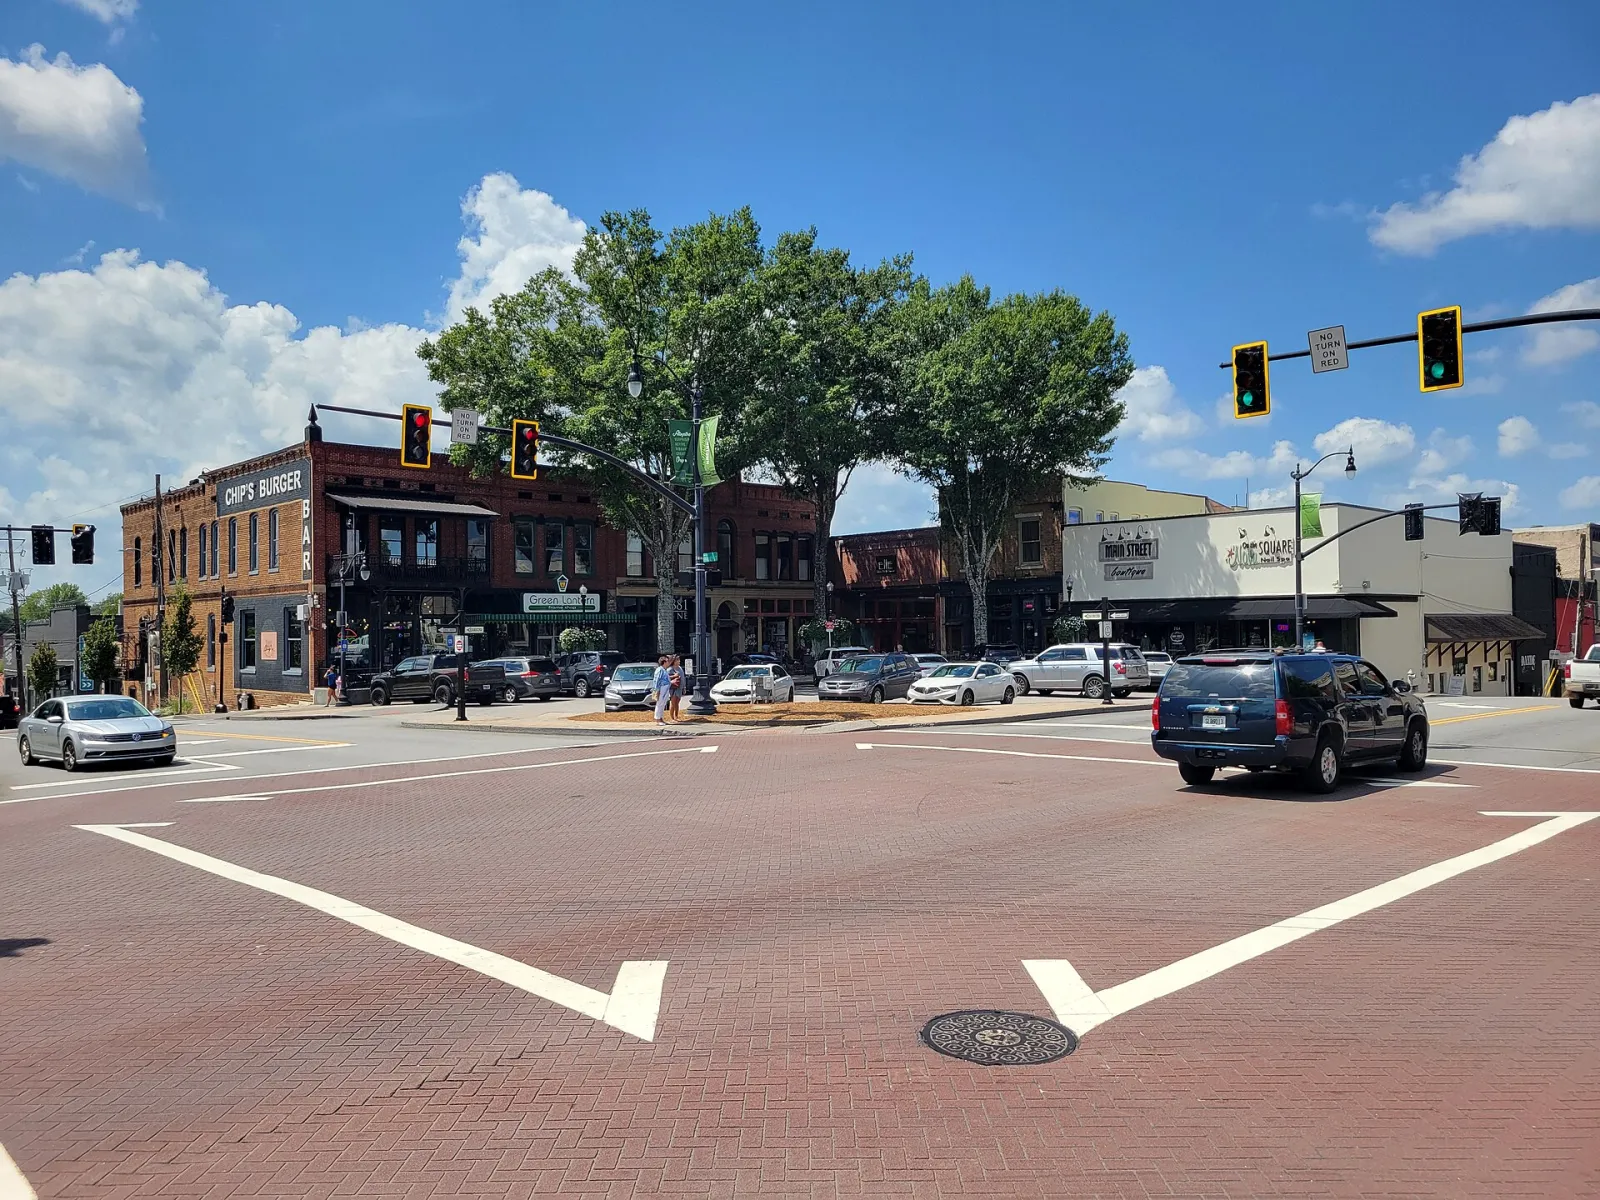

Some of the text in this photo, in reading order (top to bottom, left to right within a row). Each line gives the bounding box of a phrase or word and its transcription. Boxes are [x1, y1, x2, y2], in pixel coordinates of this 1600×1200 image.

[1320, 333, 1333, 341] NO
[1315, 340, 1341, 351] TURN
[1322, 350, 1336, 358] ON
[1320, 358, 1339, 367] RED
[460, 412, 471, 420] NO
[225, 470, 302, 506] CHIP'S BURGER
[302, 499, 312, 571] BAR
[1105, 542, 1153, 558] MAIN STREET
[1258, 540, 1292, 555] SQUARE
[1110, 566, 1146, 579] boutique
[529, 594, 595, 605] Green Lantrn
